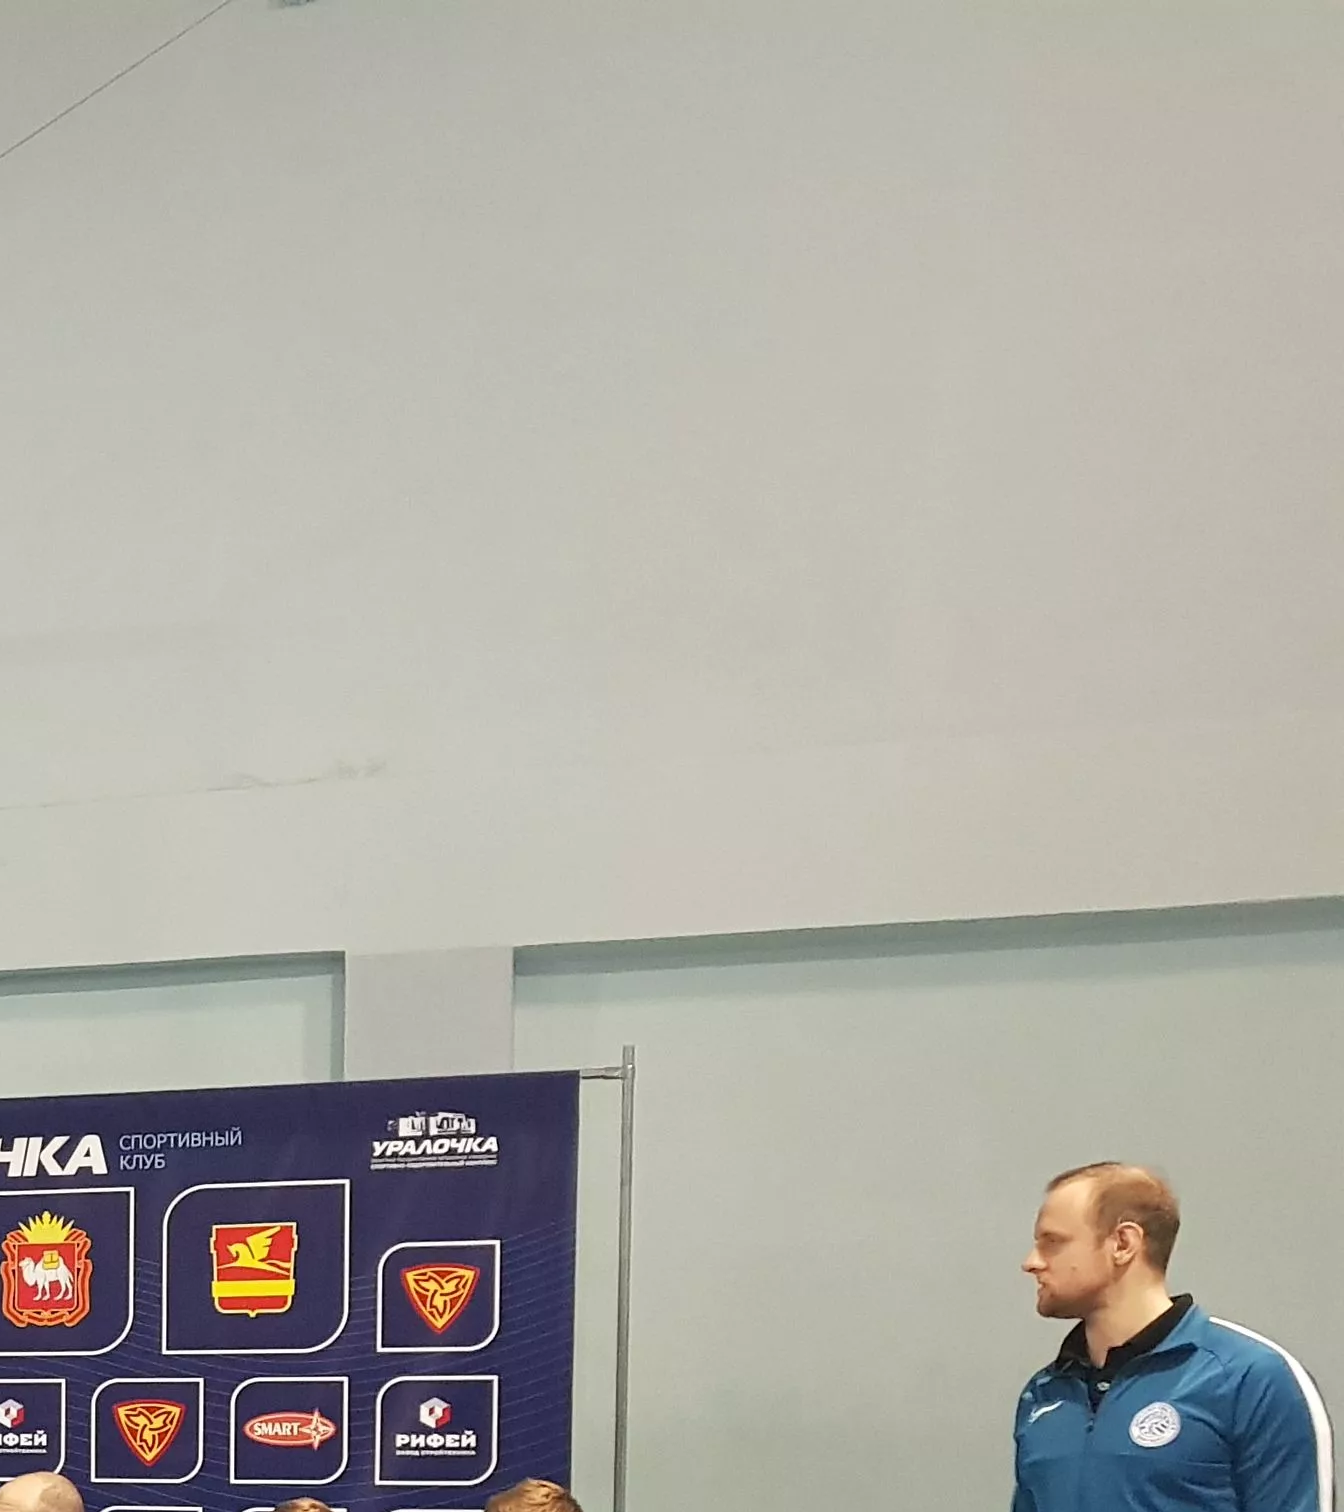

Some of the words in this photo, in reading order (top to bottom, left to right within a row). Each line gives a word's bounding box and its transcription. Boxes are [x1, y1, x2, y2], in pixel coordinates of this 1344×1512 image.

[119, 1127, 242, 1151] СПОРТИВНЫЙ
[372, 1136, 499, 1156] УРАЛОЧКА
[119, 1154, 166, 1171] КЛУБ
[253, 1422, 301, 1436] SMART
[396, 1430, 477, 1448] РИФЕЙ
